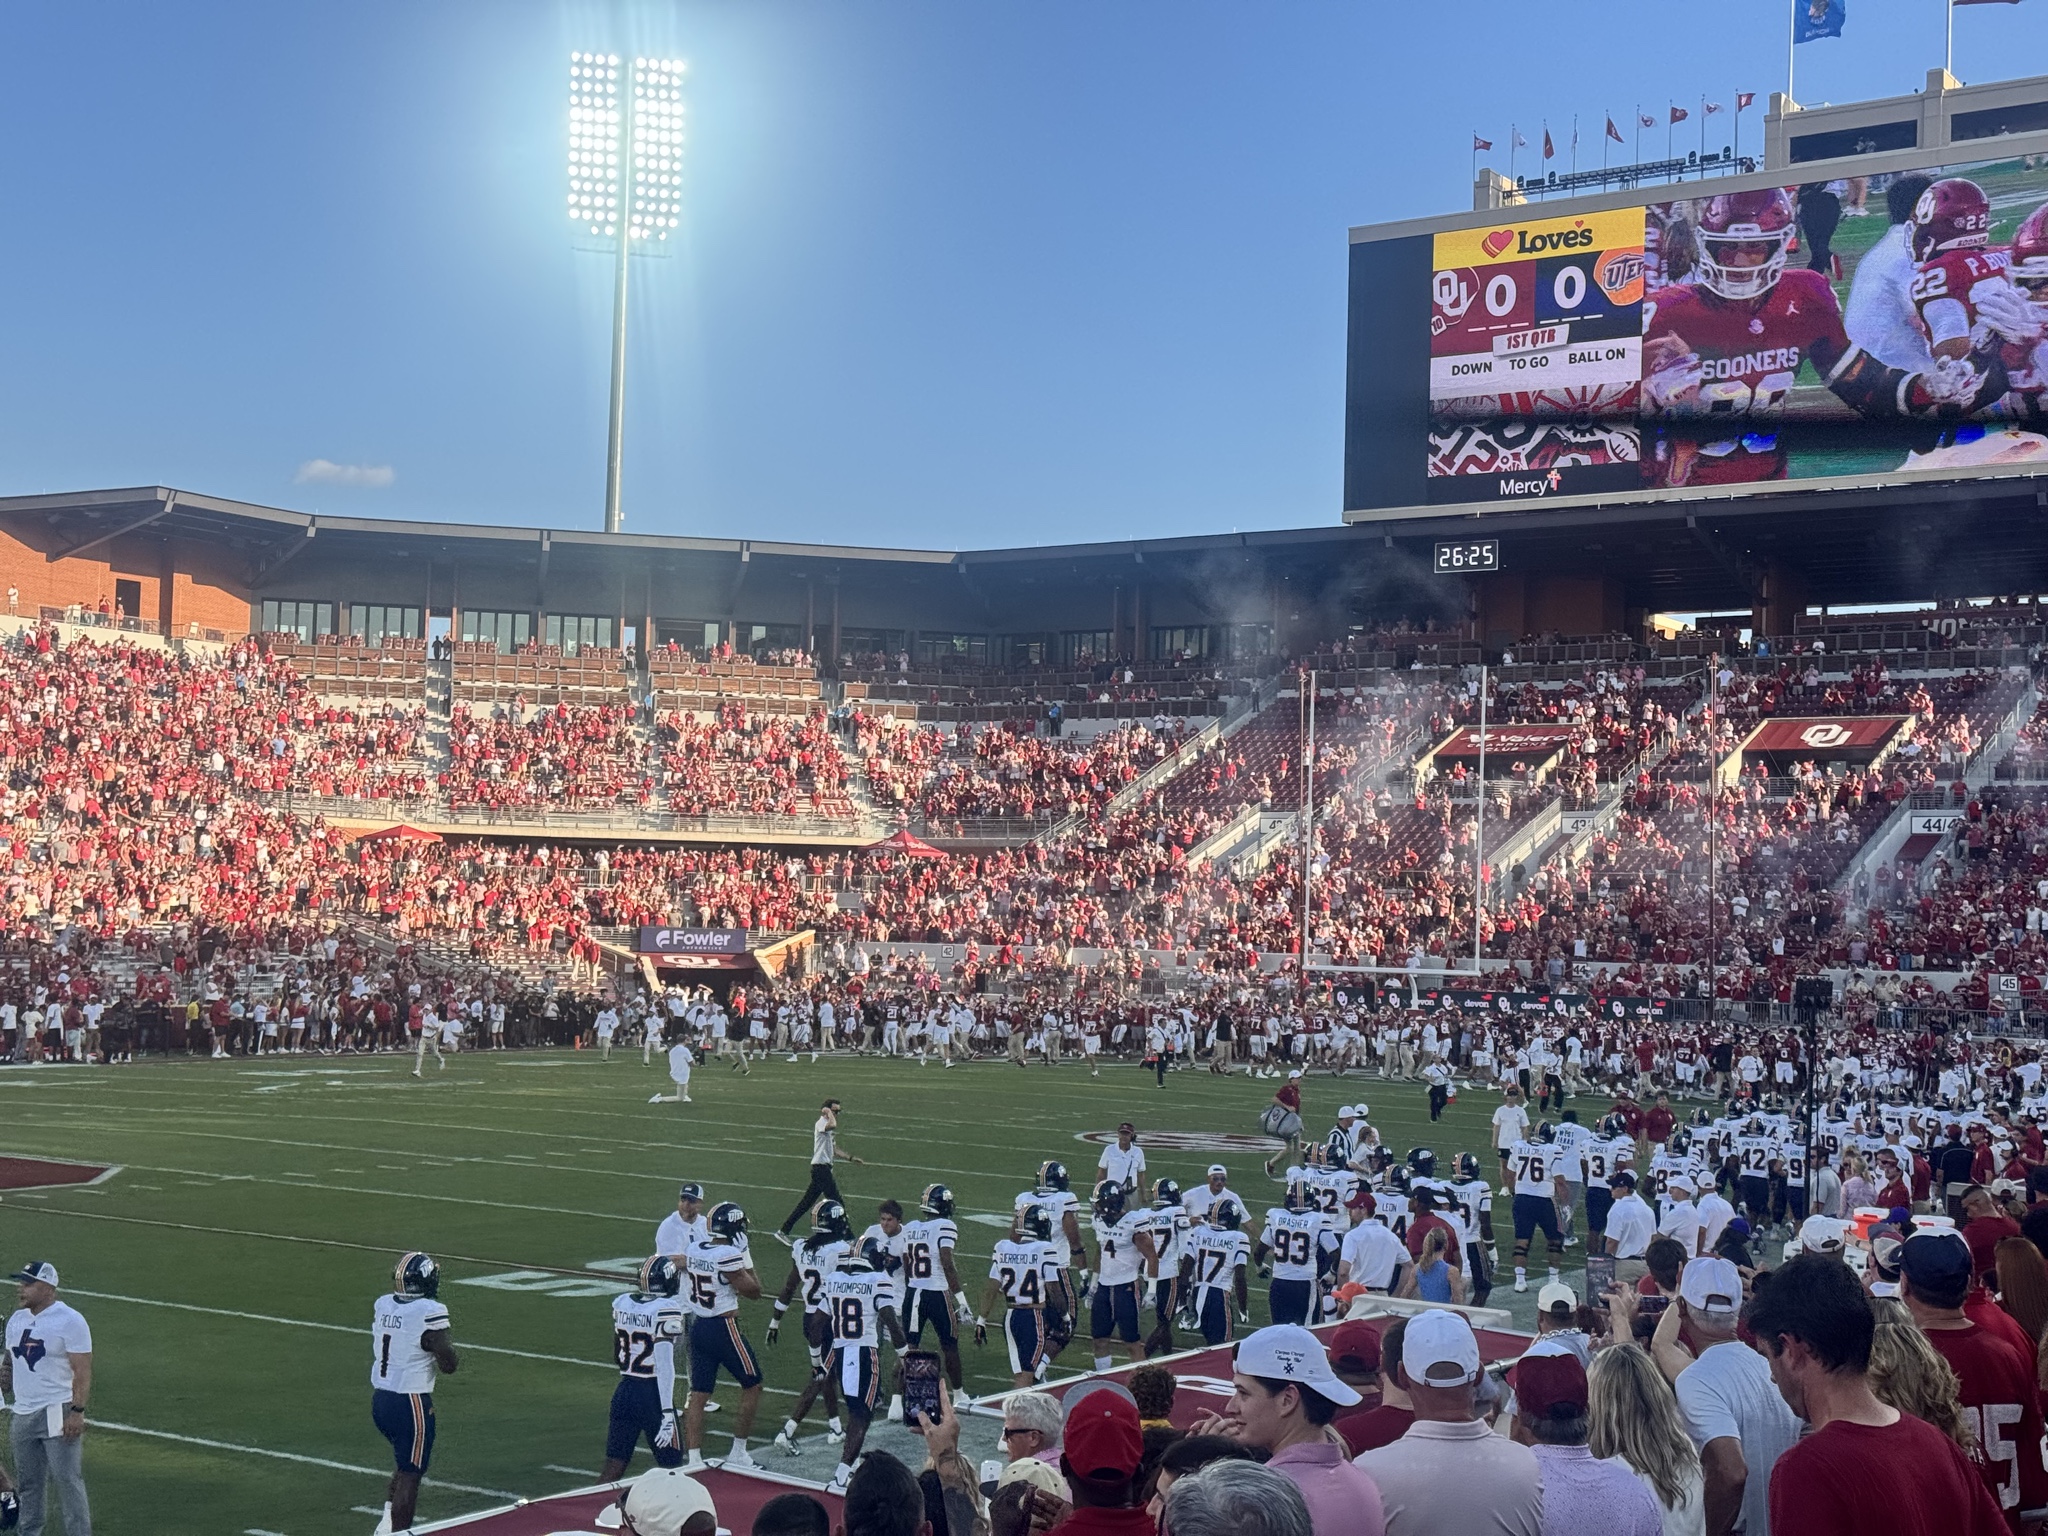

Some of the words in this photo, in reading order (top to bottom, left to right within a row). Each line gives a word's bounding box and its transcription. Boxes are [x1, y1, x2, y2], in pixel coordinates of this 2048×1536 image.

[1966, 213, 1987, 230] 22
[1554, 265, 1587, 309] 0
[1603, 253, 1644, 290] UTEP
[1911, 267, 1948, 300] 22
[1433, 270, 1468, 317] OU
[1485, 274, 1517, 317] 0
[1432, 317, 1443, 333] 10
[1507, 332, 1529, 350] 1ST
[1530, 328, 1556, 348] QTR
[1509, 358, 1528, 370] TO
[1529, 356, 1549, 368] GO
[1568, 351, 1603, 365] BALL
[1605, 348, 1626, 360] ON
[1701, 347, 1799, 380] SOONERS
[1452, 361, 1493, 376] DOWN
[1500, 478, 1548, 496] Mercy
[1439, 545, 1494, 567] 26:25
[1500, 734, 1569, 742] Valero
[1800, 723, 1853, 748] OU
[673, 930, 731, 946] Fowler
[2002, 978, 2016, 989] 45
[1518, 1156, 1544, 1183] 76
[1591, 1155, 1605, 1178] 3
[1740, 1148, 1766, 1170] 42
[1382, 1202, 1397, 1213] LEON
[1103, 1239, 1116, 1259] 4
[1201, 1236, 1235, 1251] WILLIAMS
[1274, 1229, 1310, 1266] 93
[906, 1243, 932, 1279] 16
[1029, 1254, 1039, 1265] JR
[1197, 1248, 1227, 1284] 17
[803, 1268, 821, 1306] 2
[1000, 1267, 1040, 1305] 24
[832, 1296, 863, 1340] 18
[380, 1333, 392, 1378] 1
[1960, 1404, 2024, 1511] 5
